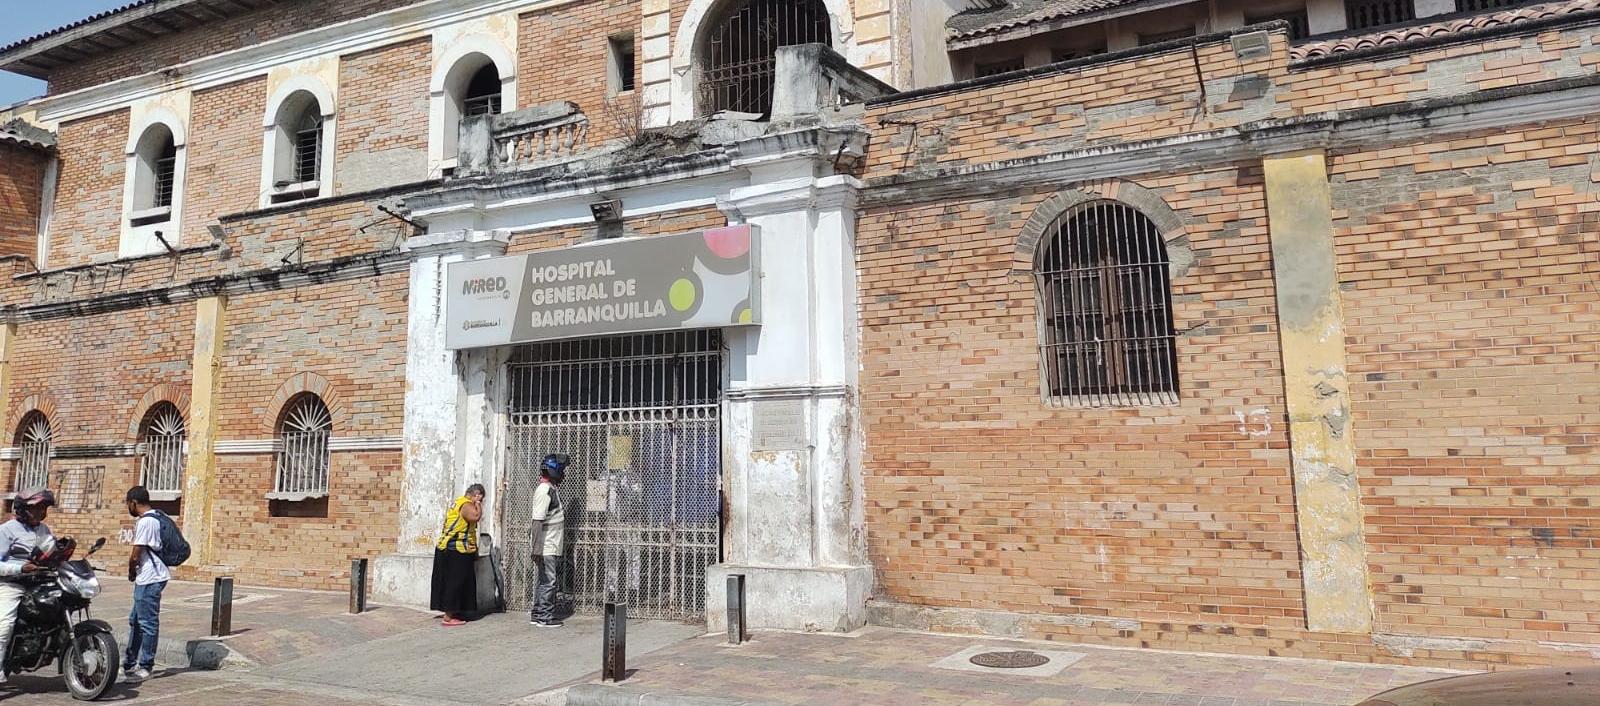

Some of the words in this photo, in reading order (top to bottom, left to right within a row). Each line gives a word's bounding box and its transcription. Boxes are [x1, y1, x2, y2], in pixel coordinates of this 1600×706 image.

[532, 259, 615, 284] HOSPITAL
[531, 281, 608, 306] GENERAL
[612, 279, 637, 298] DE
[531, 299, 667, 328] BARRANQUILLA
